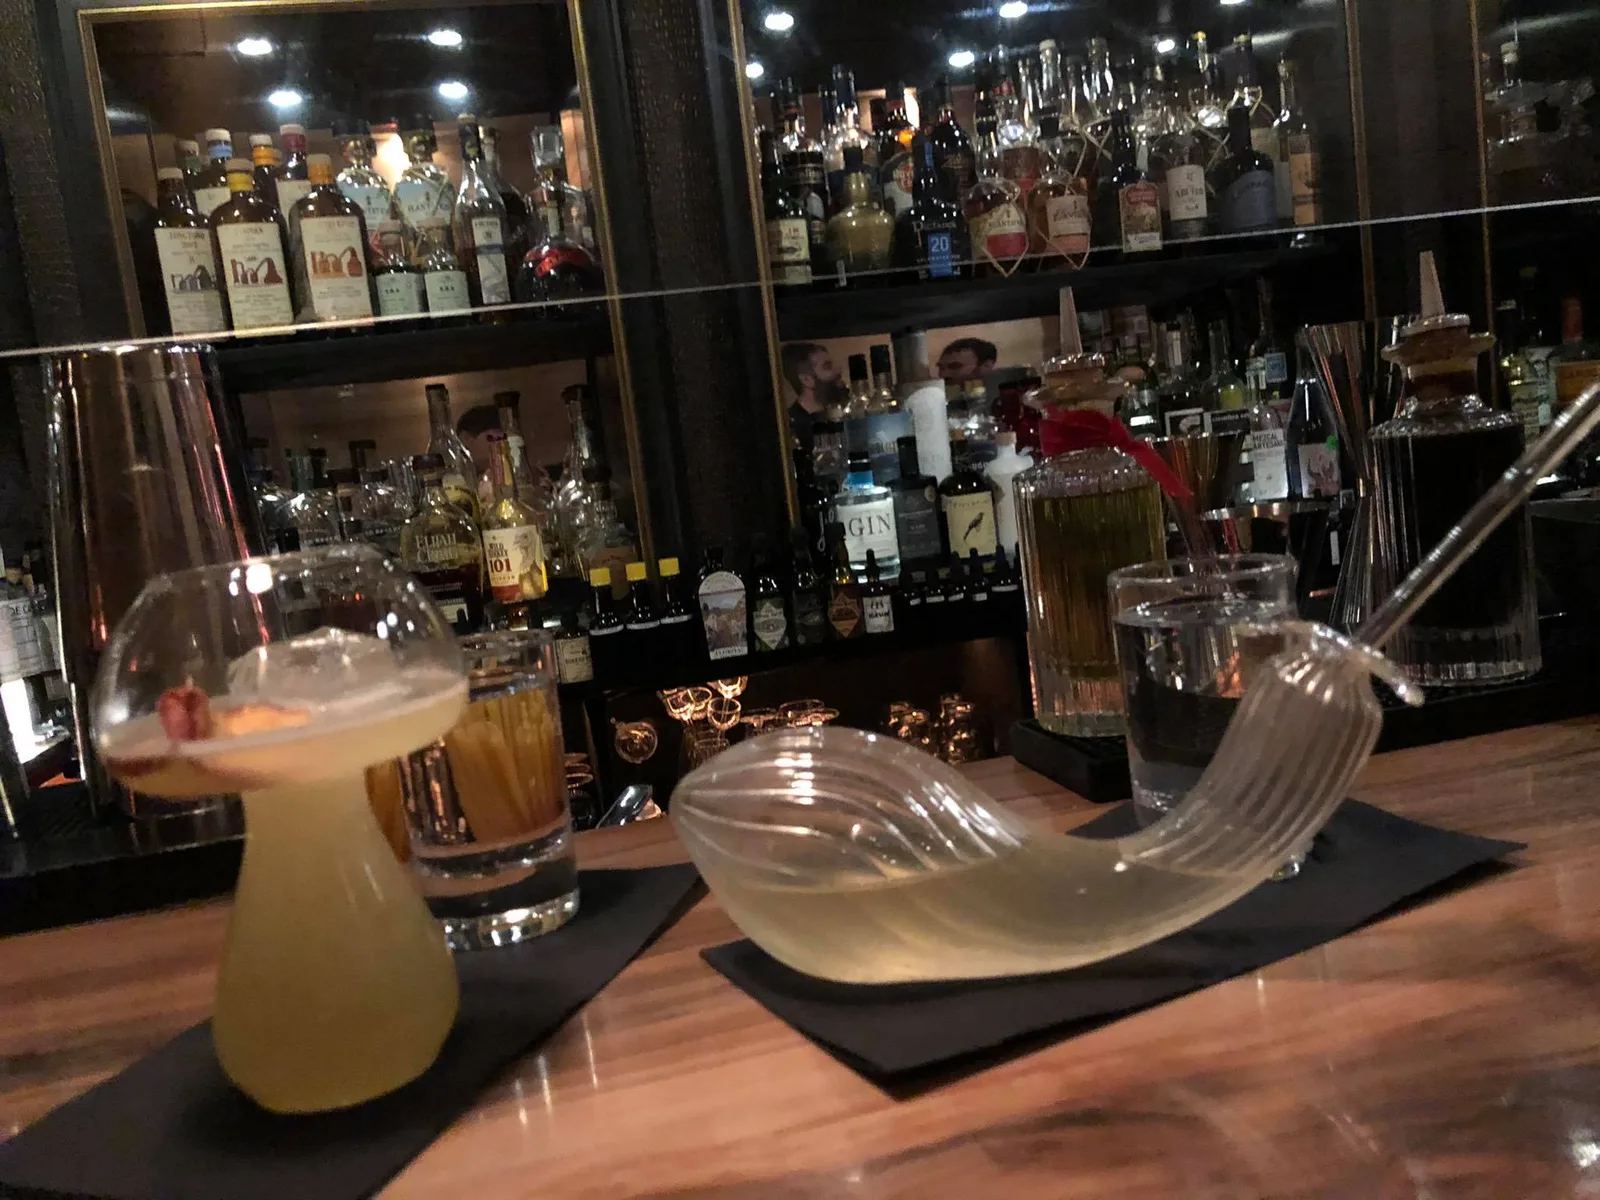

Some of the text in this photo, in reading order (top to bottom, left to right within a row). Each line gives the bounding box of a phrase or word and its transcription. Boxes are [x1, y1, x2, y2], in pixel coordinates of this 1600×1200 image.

[931, 235, 950, 253] 20
[848, 512, 893, 537] GIN
[489, 558, 512, 574] 101
